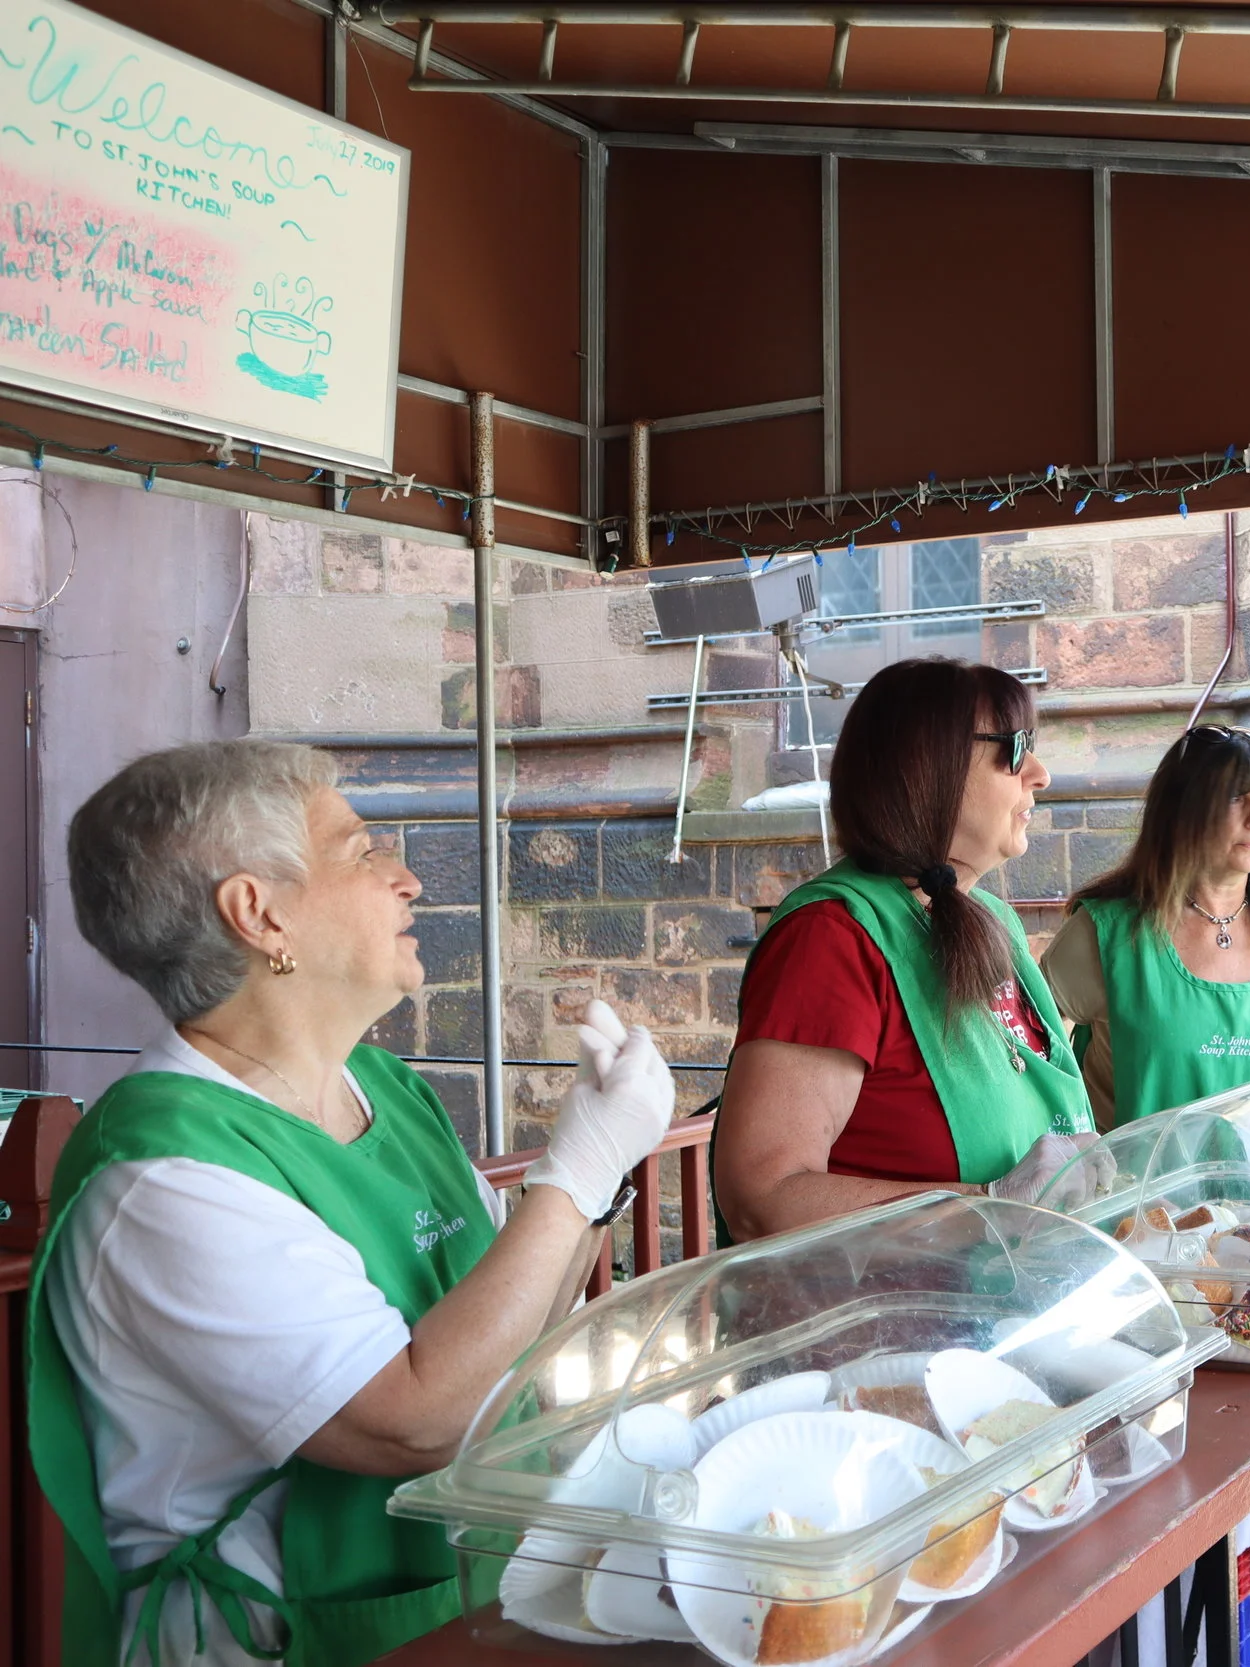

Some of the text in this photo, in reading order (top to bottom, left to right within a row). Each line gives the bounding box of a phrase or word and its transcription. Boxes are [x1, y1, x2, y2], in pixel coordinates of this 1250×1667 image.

[28, 16, 314, 190] Welcome
[51, 120, 93, 150] TO
[231, 180, 276, 206] SOUP
[363, 151, 396, 175] 2019
[136, 177, 232, 220] KITCHEN!
[1200, 1044, 1225, 1058] Soup
[1210, 1034, 1225, 1046] St.
[1052, 1113, 1071, 1127] St.
